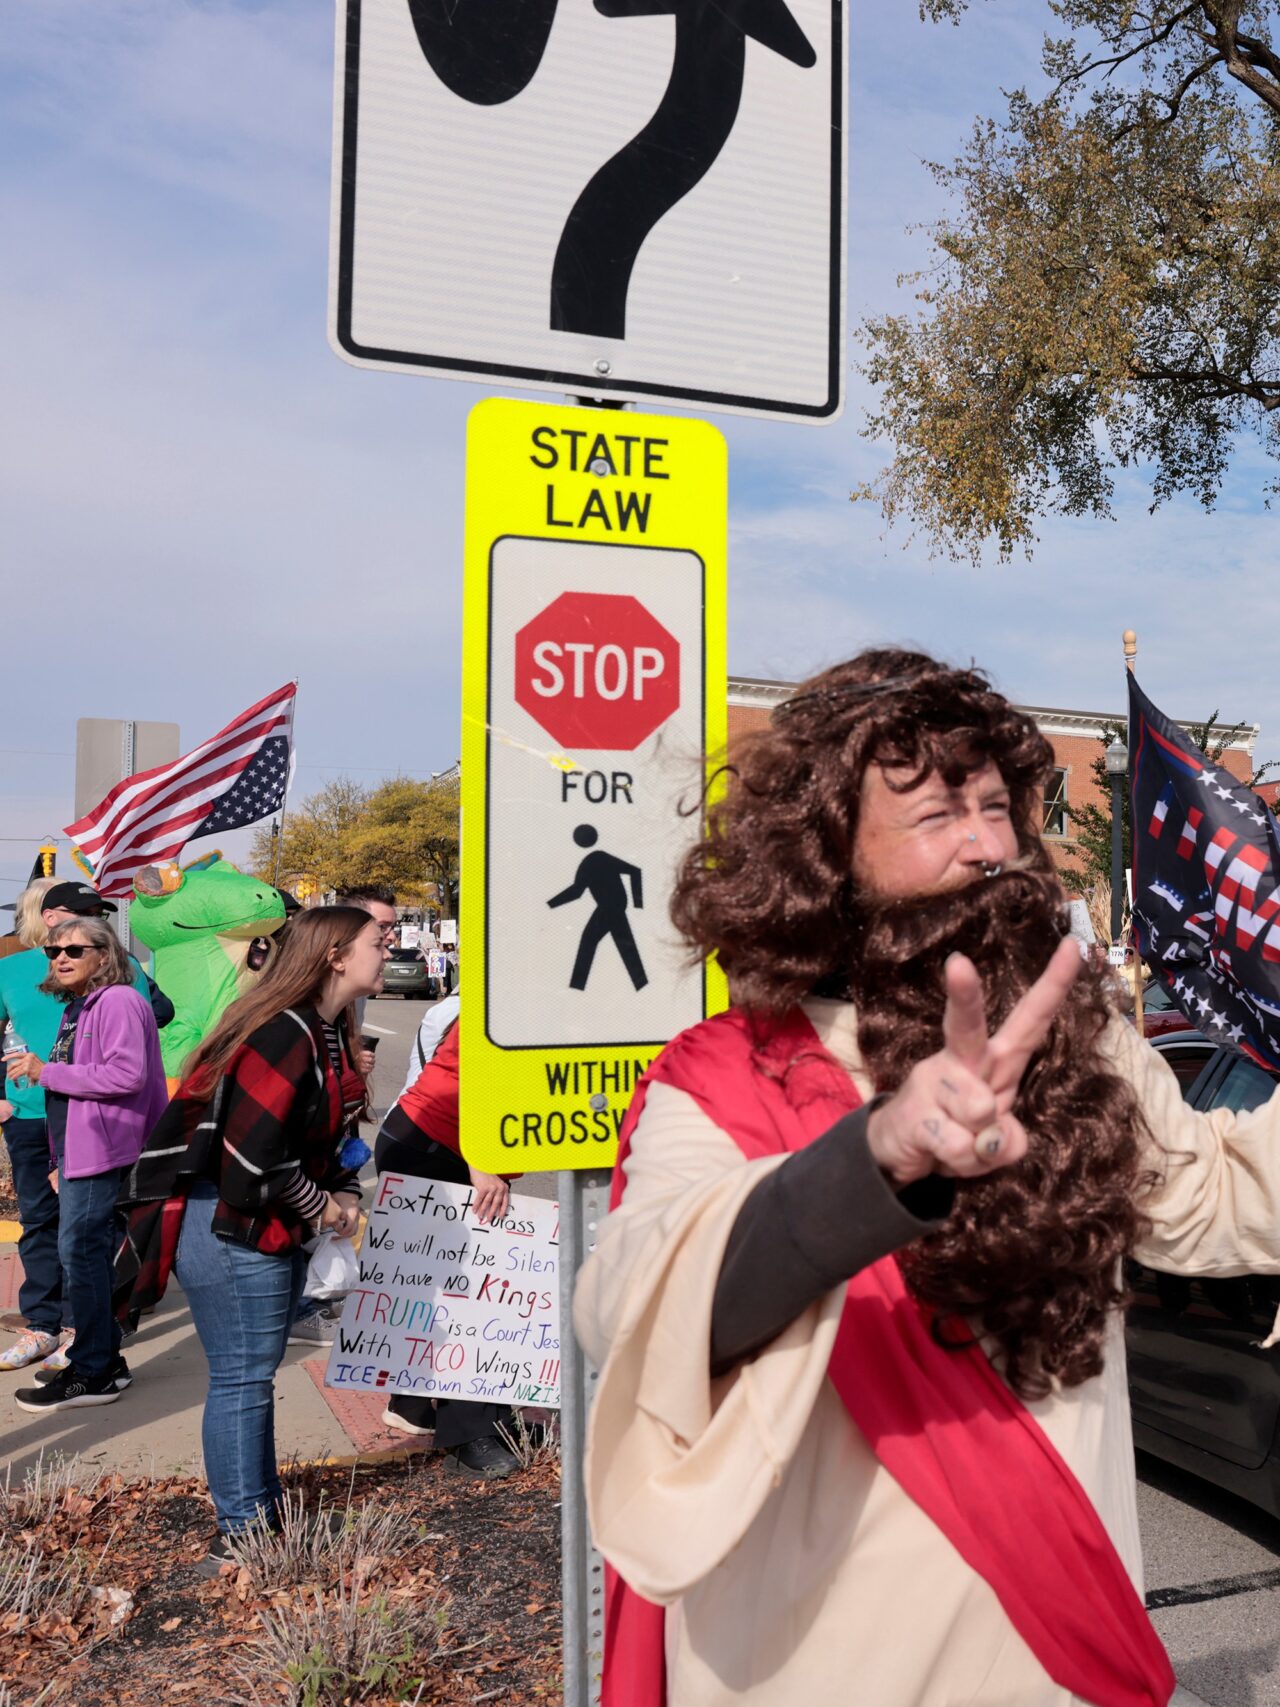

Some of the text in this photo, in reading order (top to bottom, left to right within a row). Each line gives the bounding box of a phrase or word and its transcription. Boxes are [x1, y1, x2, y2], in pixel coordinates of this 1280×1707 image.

[530, 426, 670, 479] STATE
[546, 484, 652, 533] LAW
[531, 641, 665, 701] STOP
[562, 770, 634, 804] FOR
[377, 1176, 473, 1222] Foxtrot
[370, 1226, 394, 1250] We
[404, 1235, 432, 1256] will
[436, 1242, 468, 1269] not
[472, 1244, 495, 1266] be
[360, 1261, 552, 1318] We have NO Kings
[355, 1289, 448, 1333] TRUMP
[449, 1319, 461, 1336] is
[466, 1325, 477, 1337] a
[483, 1318, 532, 1346] Court
[334, 1364, 375, 1386] ICE
[340, 1328, 391, 1358] With
[405, 1337, 465, 1373] TACO
[476, 1347, 532, 1388] Wings
